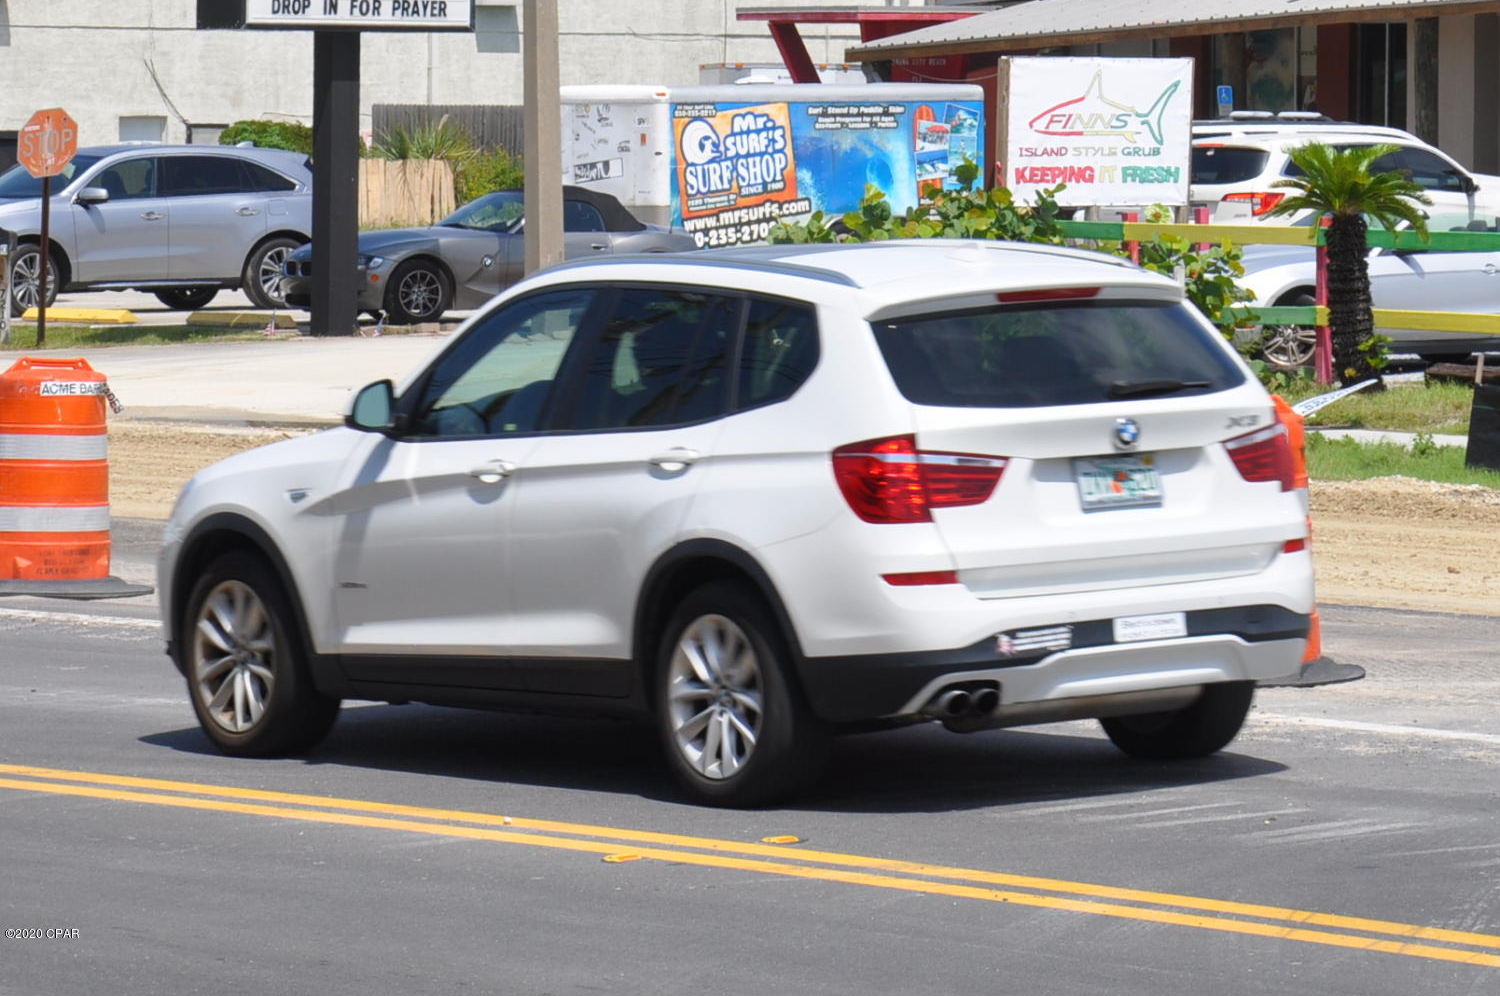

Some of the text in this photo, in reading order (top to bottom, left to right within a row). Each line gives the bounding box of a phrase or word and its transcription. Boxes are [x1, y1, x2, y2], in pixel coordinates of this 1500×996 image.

[323, 0, 338, 15] IN
[350, 0, 381, 16] FOR
[392, 0, 447, 17] PRAYER
[733, 113, 775, 133] Mr.
[1045, 113, 1132, 130] FINNS
[23, 128, 73, 157] STOP
[725, 127, 786, 158] SURF'S
[1018, 146, 1162, 158] ISLAND STYLE GRUB
[685, 152, 787, 195] SURF SHOP
[1015, 165, 1180, 184] KEEPING IT FRESH
[741, 185, 763, 196] SINCE
[684, 200, 810, 232] www.mrsurfs.com
[42, 383, 77, 395] ACME
